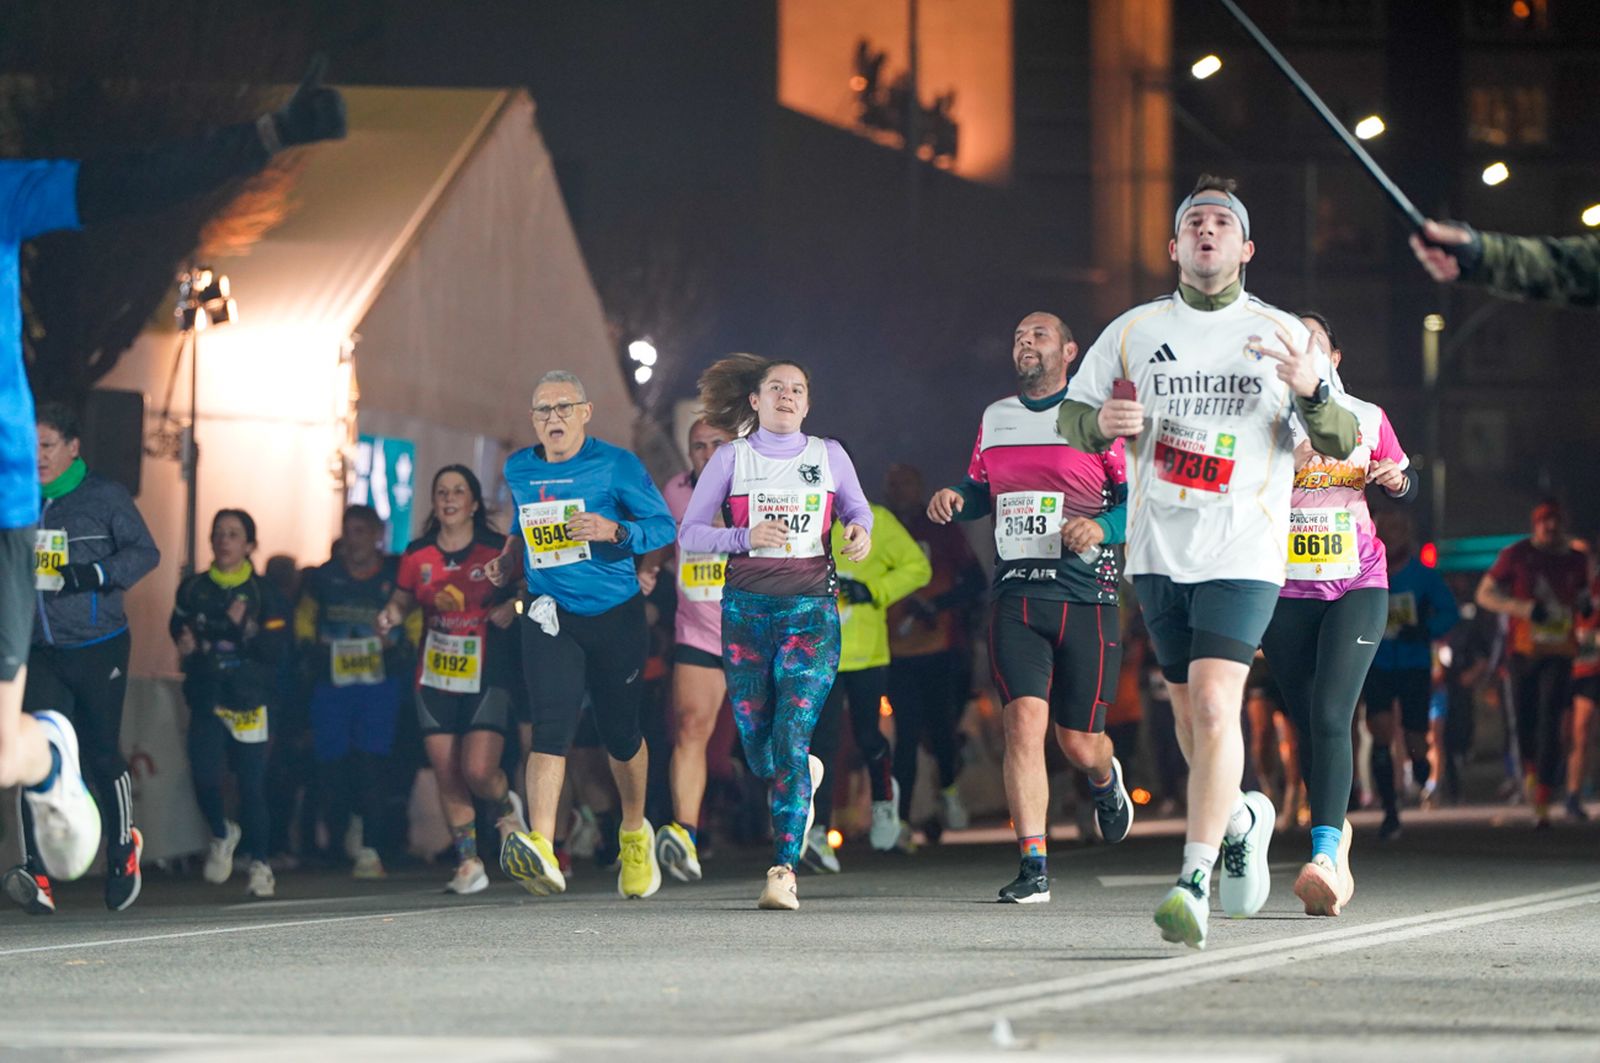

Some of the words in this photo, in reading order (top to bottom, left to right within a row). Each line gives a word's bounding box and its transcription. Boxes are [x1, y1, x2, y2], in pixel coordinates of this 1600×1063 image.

[1153, 370, 1262, 396] Emirates
[1168, 398, 1191, 416] FLY
[1194, 397, 1245, 416] BETTER
[1163, 447, 1220, 483] 9736
[758, 504, 773, 512] SAN
[1005, 515, 1047, 536] 3543
[1295, 515, 1318, 524] NOCHE
[1293, 534, 1343, 556] 6618
[692, 563, 723, 581] 1118
[433, 652, 469, 673] 8192
